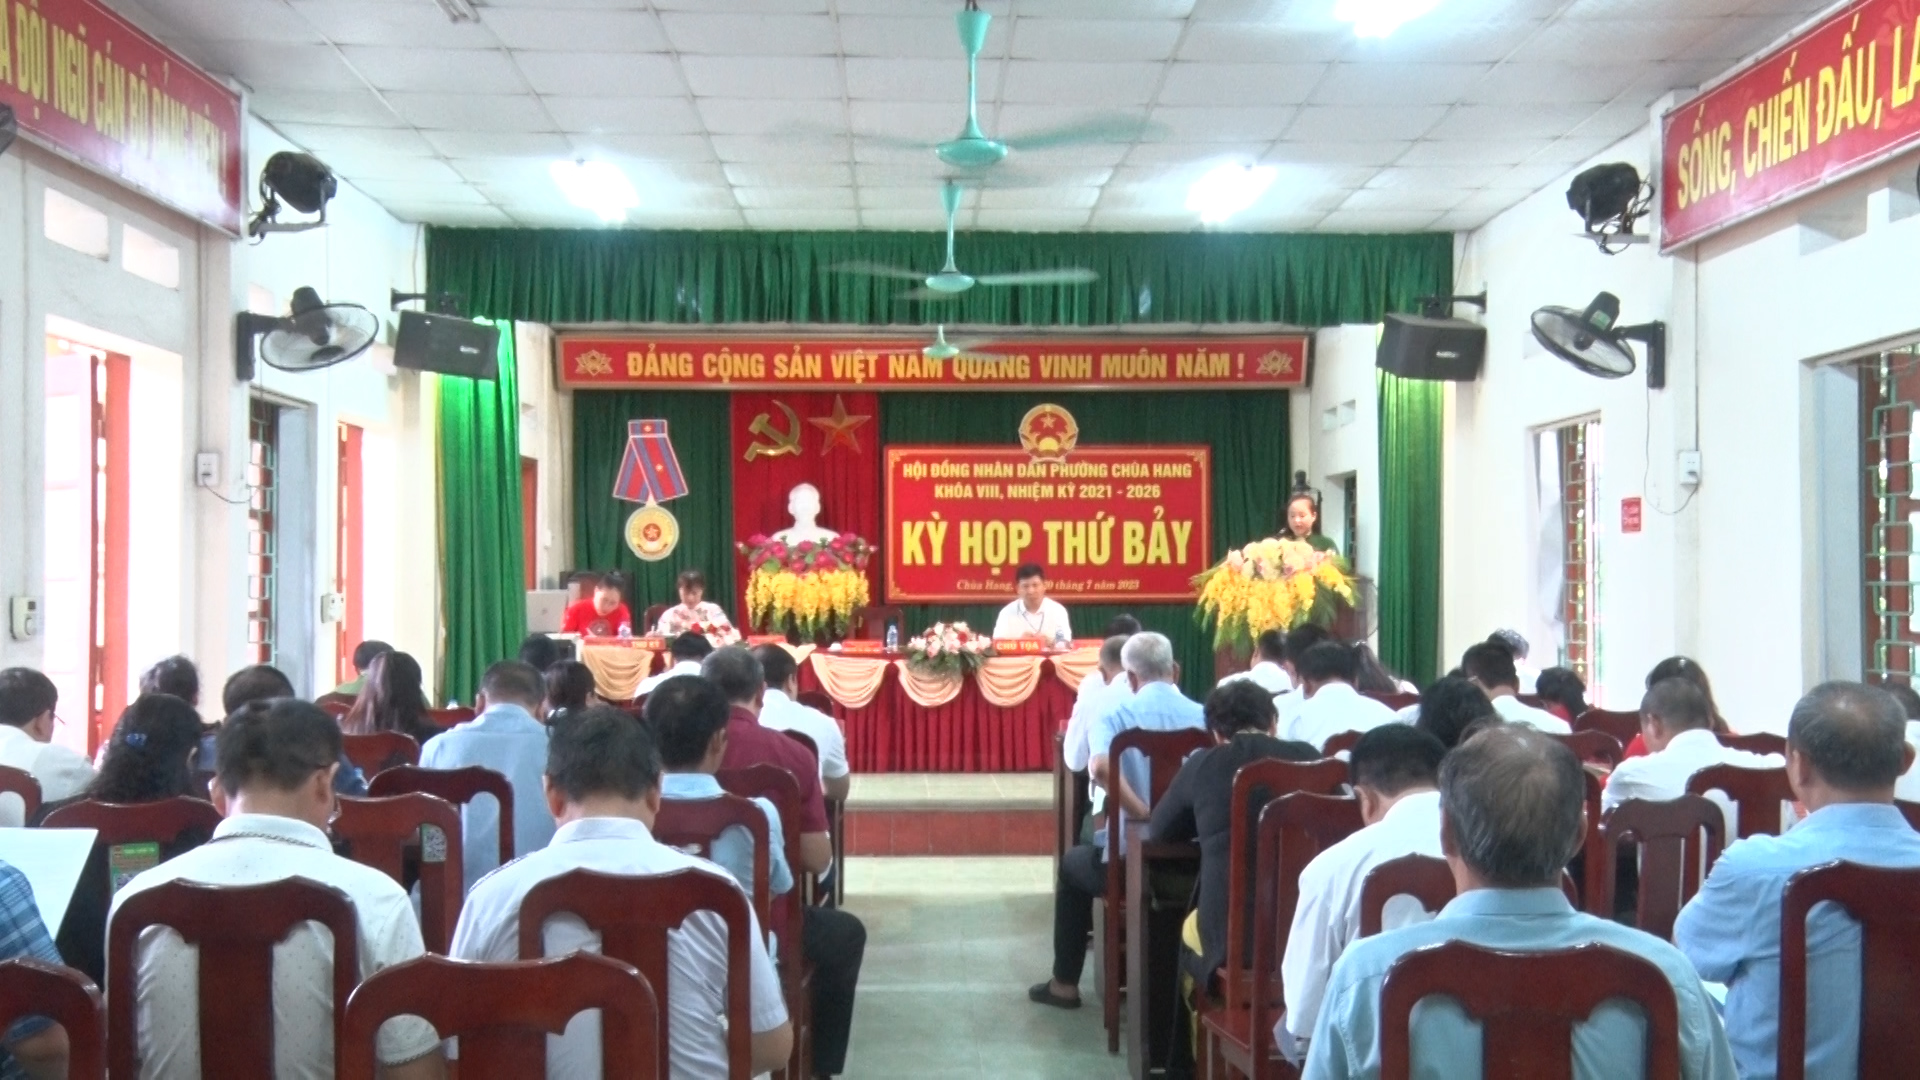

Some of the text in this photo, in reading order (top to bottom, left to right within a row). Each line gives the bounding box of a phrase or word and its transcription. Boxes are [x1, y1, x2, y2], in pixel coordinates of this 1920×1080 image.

[53, 23, 88, 126] NGŨ
[93, 40, 125, 144] CÁN
[1678, 103, 1736, 210] SỐNG,
[1743, 51, 1811, 179] CHIẾN
[1816, 13, 1882, 145] ĐẤU,
[626, 343, 693, 378] ĐẢNG
[702, 347, 765, 384] CỘNG
[773, 345, 822, 378] SẢN
[830, 349, 879, 384] VIỆT
[888, 353, 943, 378] NAM
[952, 354, 1030, 380] QUANG
[1039, 354, 1092, 379] VINH
[1101, 348, 1167, 379] MUÔN
[1176, 348, 1230, 378] NĂM
[902, 460, 927, 480] HỘI
[930, 459, 969, 478] ĐỒNG
[973, 461, 1014, 478] NHÂN
[1050, 460, 1108, 478] PHƯỜNG
[1111, 460, 1150, 478] CHÙA
[1152, 463, 1192, 478] HANG
[934, 482, 973, 498] KHÓA
[976, 484, 1004, 500] VIII,
[1007, 482, 1054, 501] NHIỆM
[1079, 484, 1112, 498] 2021
[1126, 484, 1161, 498] 2026
[902, 505, 1193, 576] KỲ HỌP THỨ BẢY
[1086, 579, 1091, 590] 7
